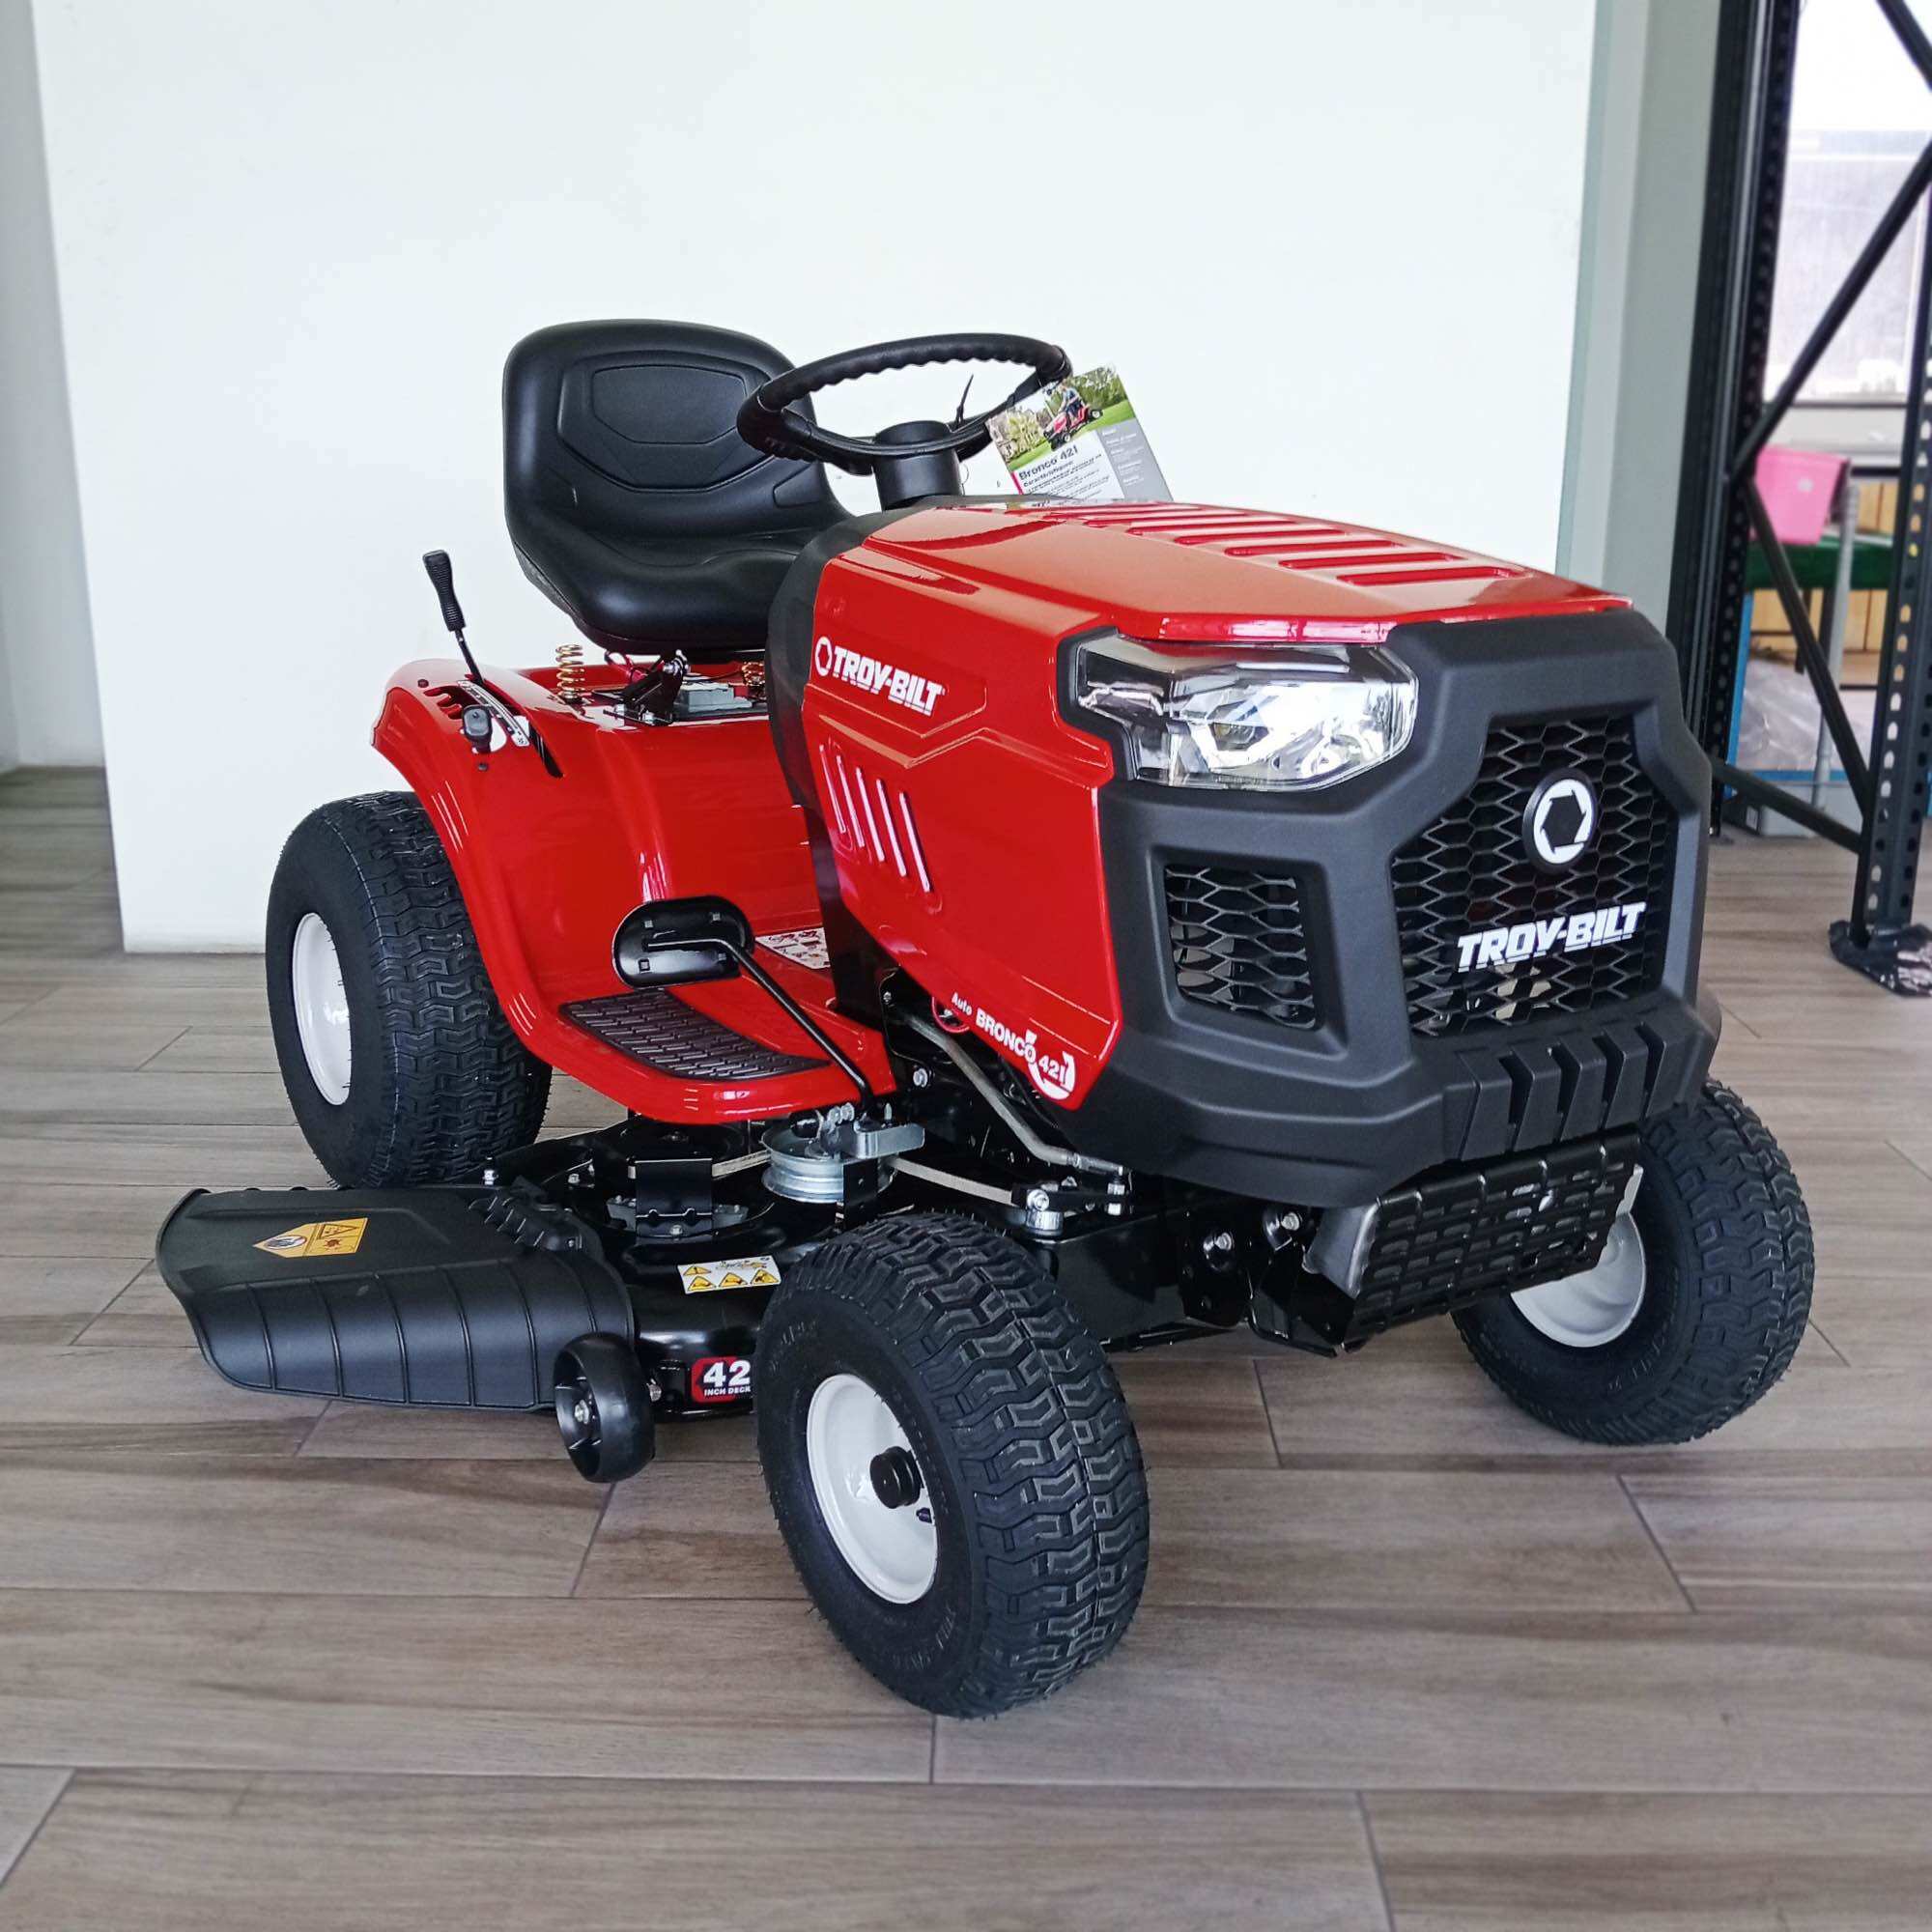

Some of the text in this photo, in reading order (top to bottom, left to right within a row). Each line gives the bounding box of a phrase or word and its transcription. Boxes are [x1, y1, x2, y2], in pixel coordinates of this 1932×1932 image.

[1018, 458, 1057, 481] Bronco
[833, 645, 944, 716] TROY-BILT
[1457, 901, 1646, 973] TROY-BILT
[952, 992, 973, 1015] Auto
[975, 1008, 1037, 1064] BRONCO
[703, 1360, 751, 1387] 42
[704, 1387, 726, 1396] INCH
